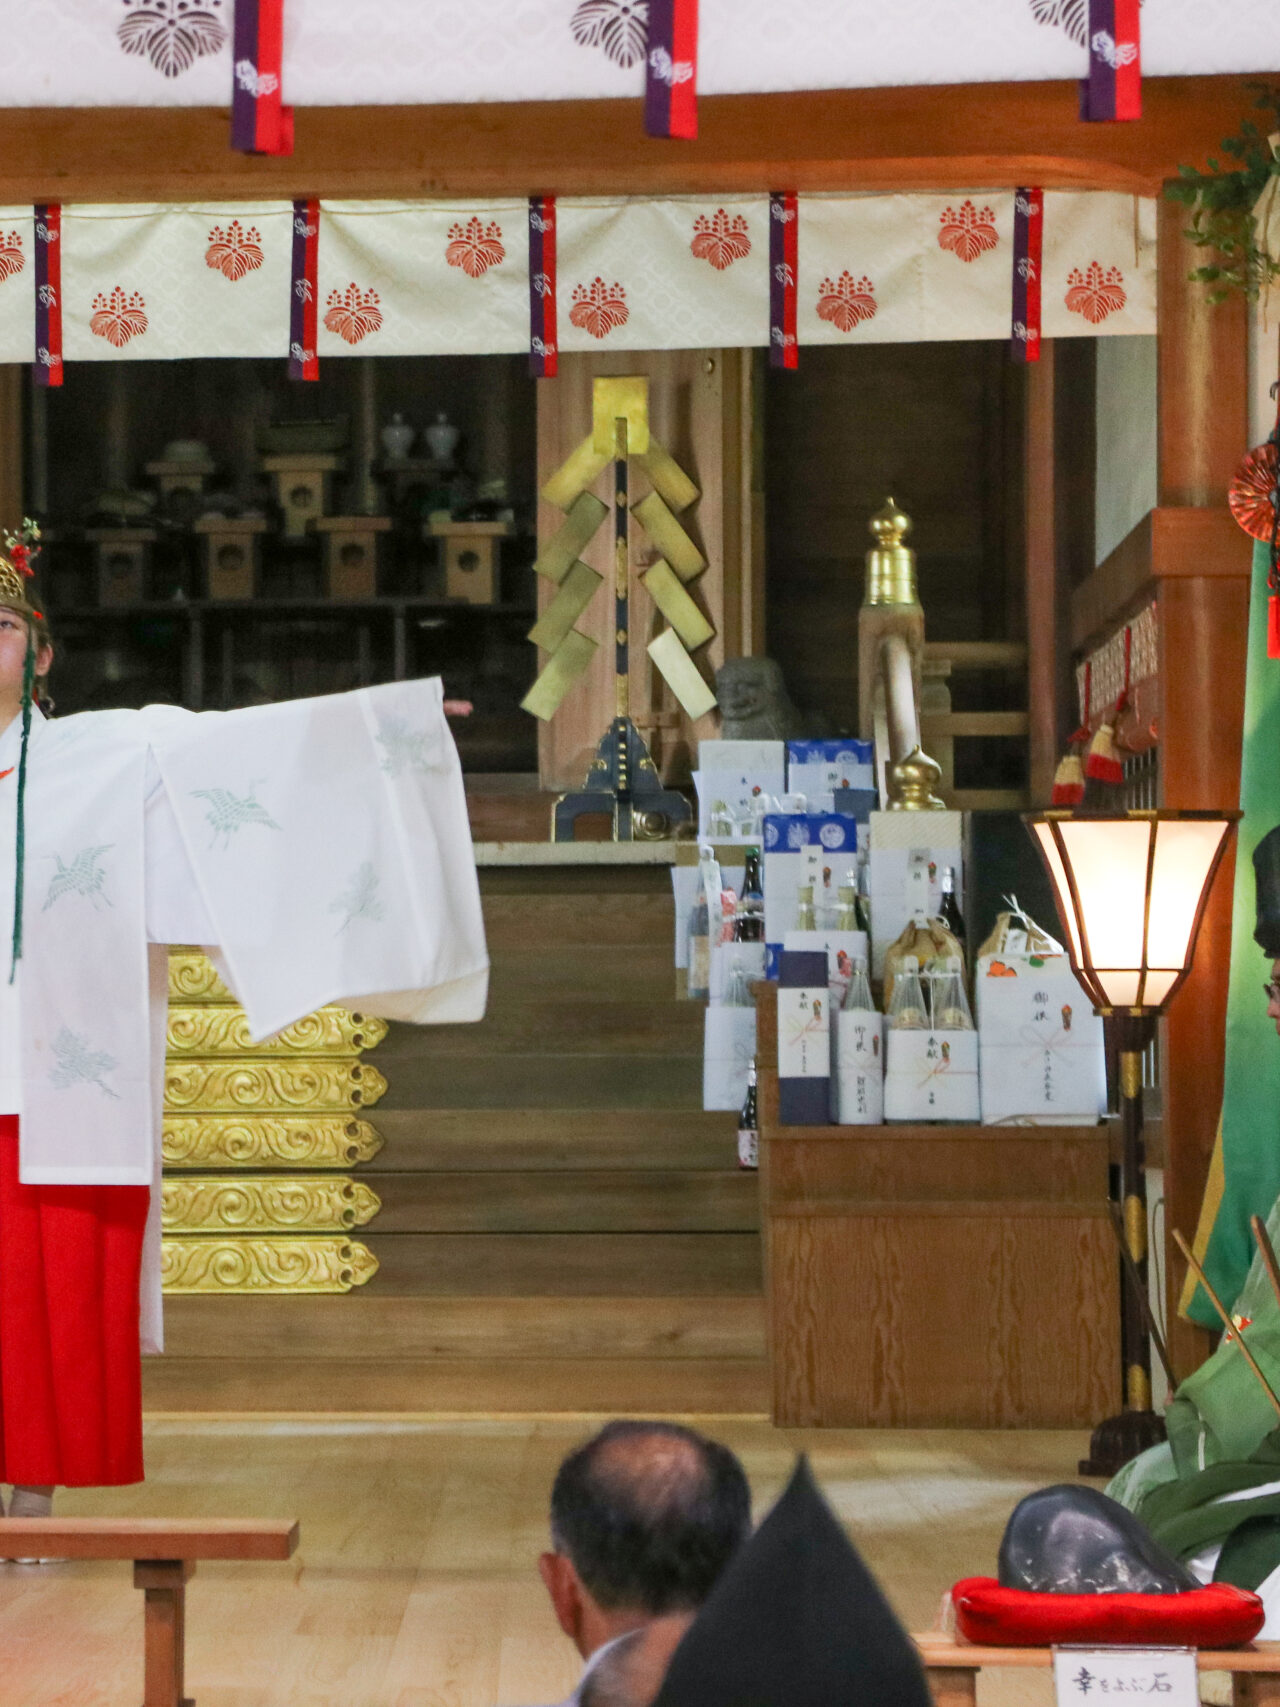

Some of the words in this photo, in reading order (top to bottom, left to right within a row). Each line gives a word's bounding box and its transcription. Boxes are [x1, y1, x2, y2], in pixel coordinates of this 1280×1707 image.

[1072, 1666, 1173, 1695] 幸をよぶ石
